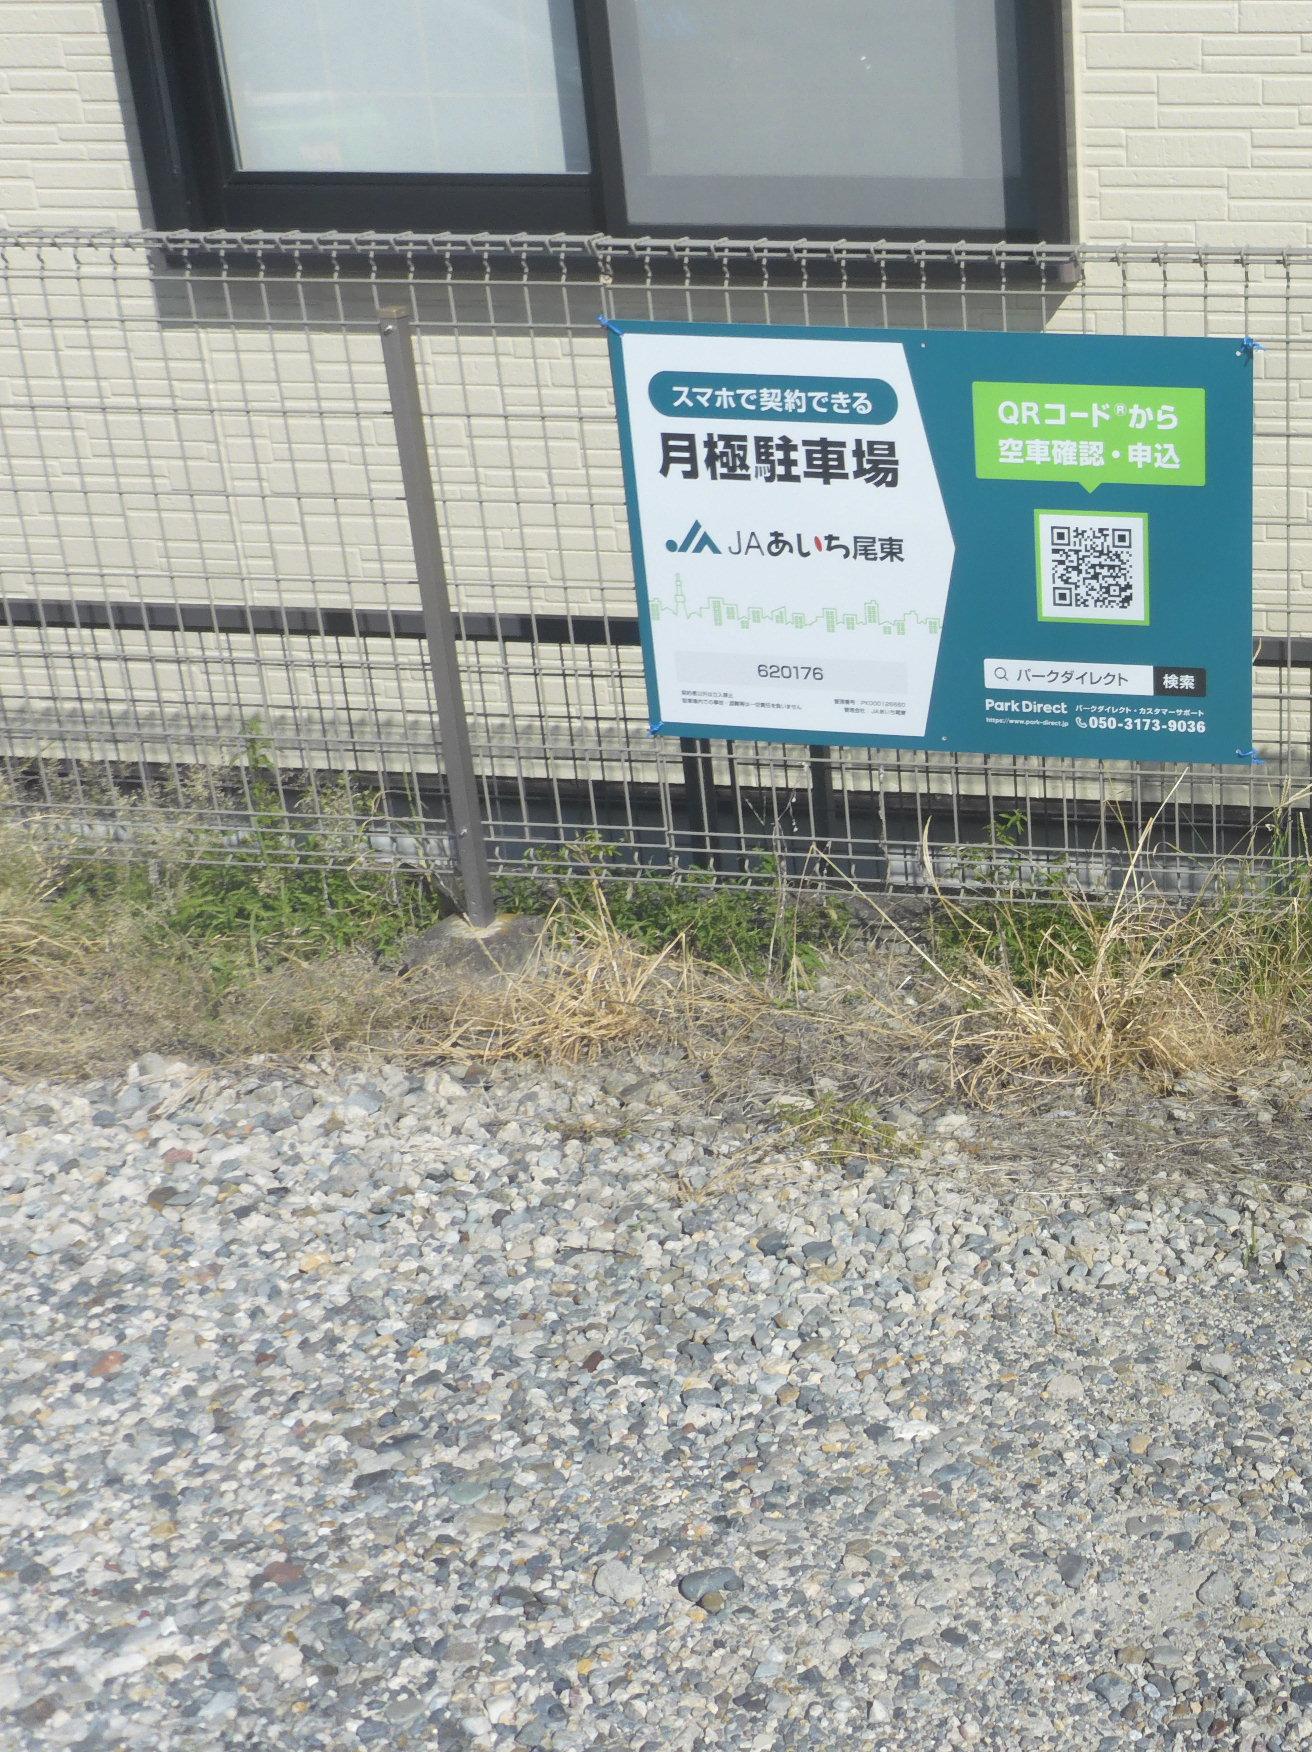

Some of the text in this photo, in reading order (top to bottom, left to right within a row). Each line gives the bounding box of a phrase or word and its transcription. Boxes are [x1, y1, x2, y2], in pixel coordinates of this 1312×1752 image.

[672, 386, 873, 414] スマホで契約できる
[659, 432, 899, 488] 月極駐車場
[998, 438, 1181, 469] 空車確認・申込
[728, 530, 905, 562] JAあいち尾東
[757, 664, 824, 681] 620176
[1017, 668, 1128, 687] パークダイレクト
[1163, 673, 1195, 690] 検索
[985, 699, 1068, 714] Park Direct
[1089, 716, 1206, 733] 050-3173-9036
